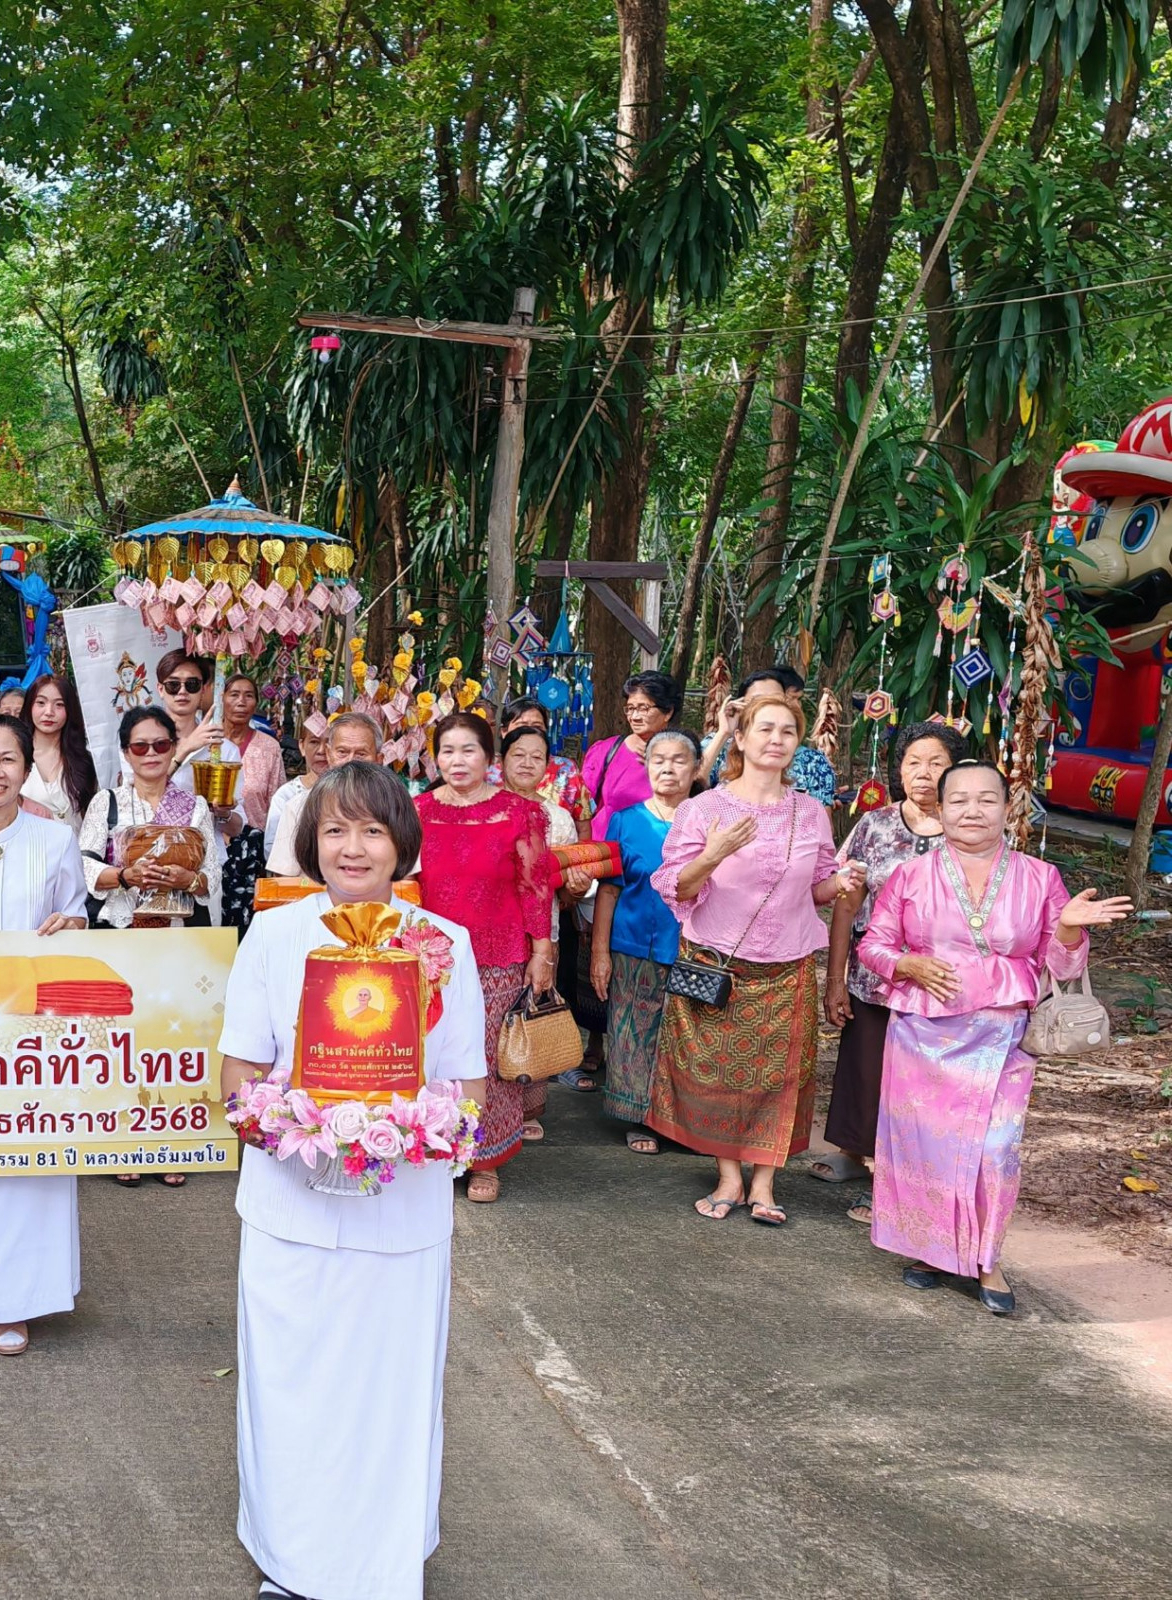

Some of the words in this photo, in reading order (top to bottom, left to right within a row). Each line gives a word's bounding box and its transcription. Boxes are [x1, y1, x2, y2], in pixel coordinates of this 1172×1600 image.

[310, 1041, 413, 1058] กฐินสามัคคีทั่วไทย
[129, 1105, 208, 1132] 2568
[36, 1152, 57, 1166] 81
[65, 1148, 77, 1166] ปี
[84, 1143, 226, 1165] หลวงพ่อธัมมชโย
